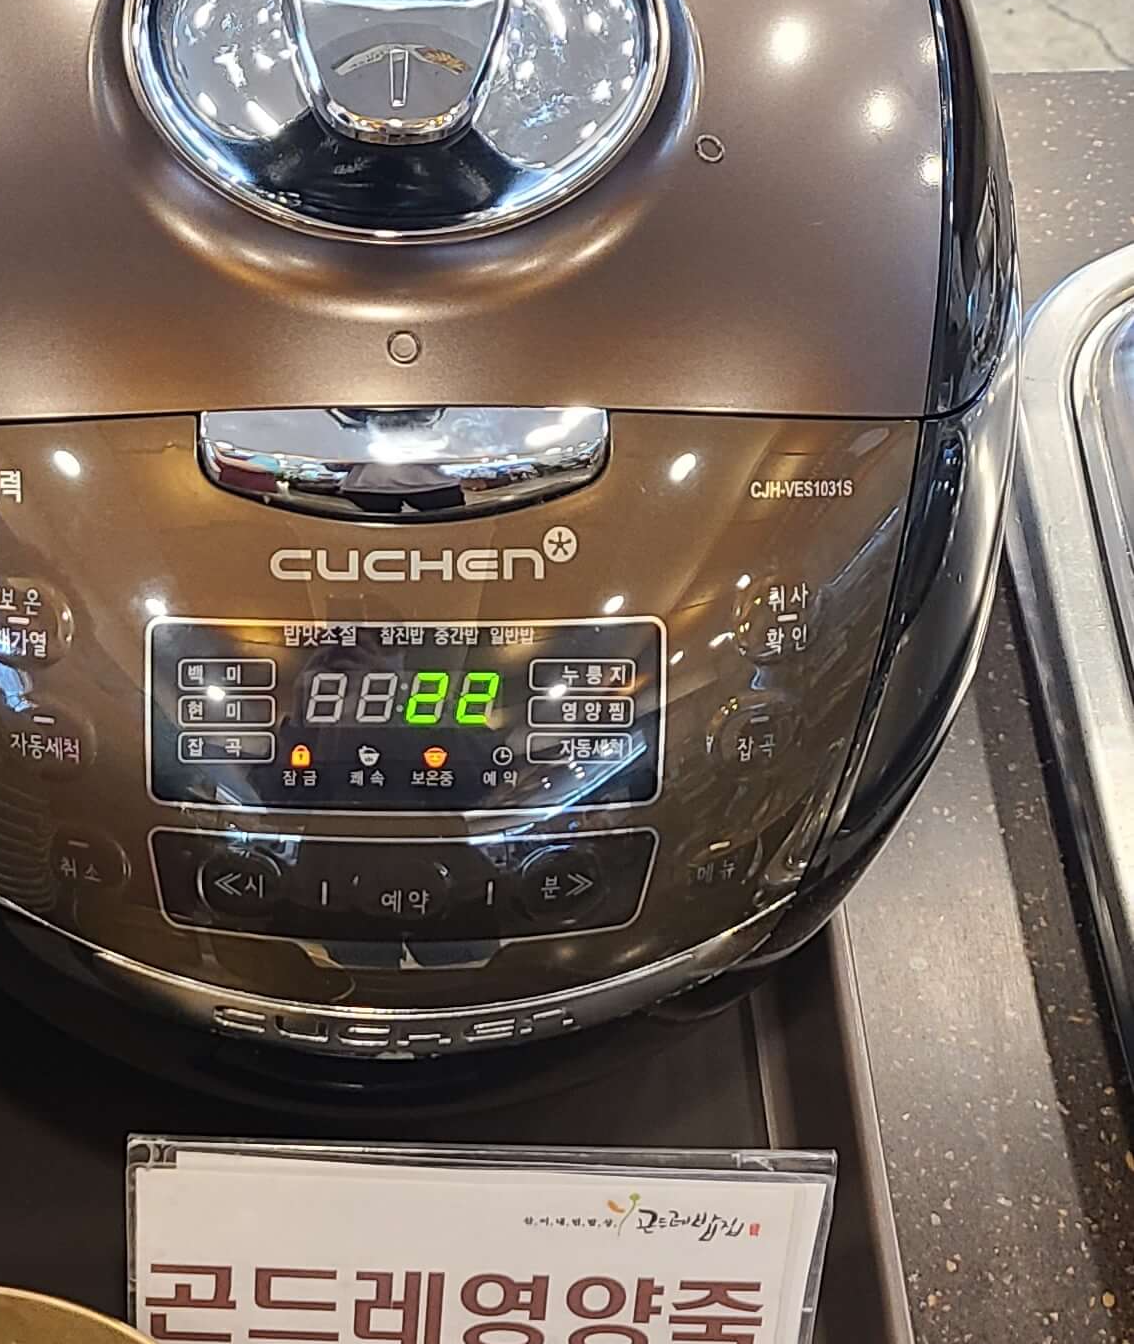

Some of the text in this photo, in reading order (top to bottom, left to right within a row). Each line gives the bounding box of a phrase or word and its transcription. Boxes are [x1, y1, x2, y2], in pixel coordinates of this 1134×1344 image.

[750, 479, 853, 498] CJH-VES1031S
[270, 549, 545, 581] CUCHEN
[768, 582, 809, 612] 취사
[284, 624, 535, 647] 밥맛조절 찰진밥 중간밥 일반밥
[765, 623, 807, 655] 확인
[10, 731, 80, 764] 자동세척
[737, 733, 776, 762] 잡곡
[411, 770, 454, 787] 보온중
[483, 770, 518, 788] 예약
[380, 889, 431, 915] 예약
